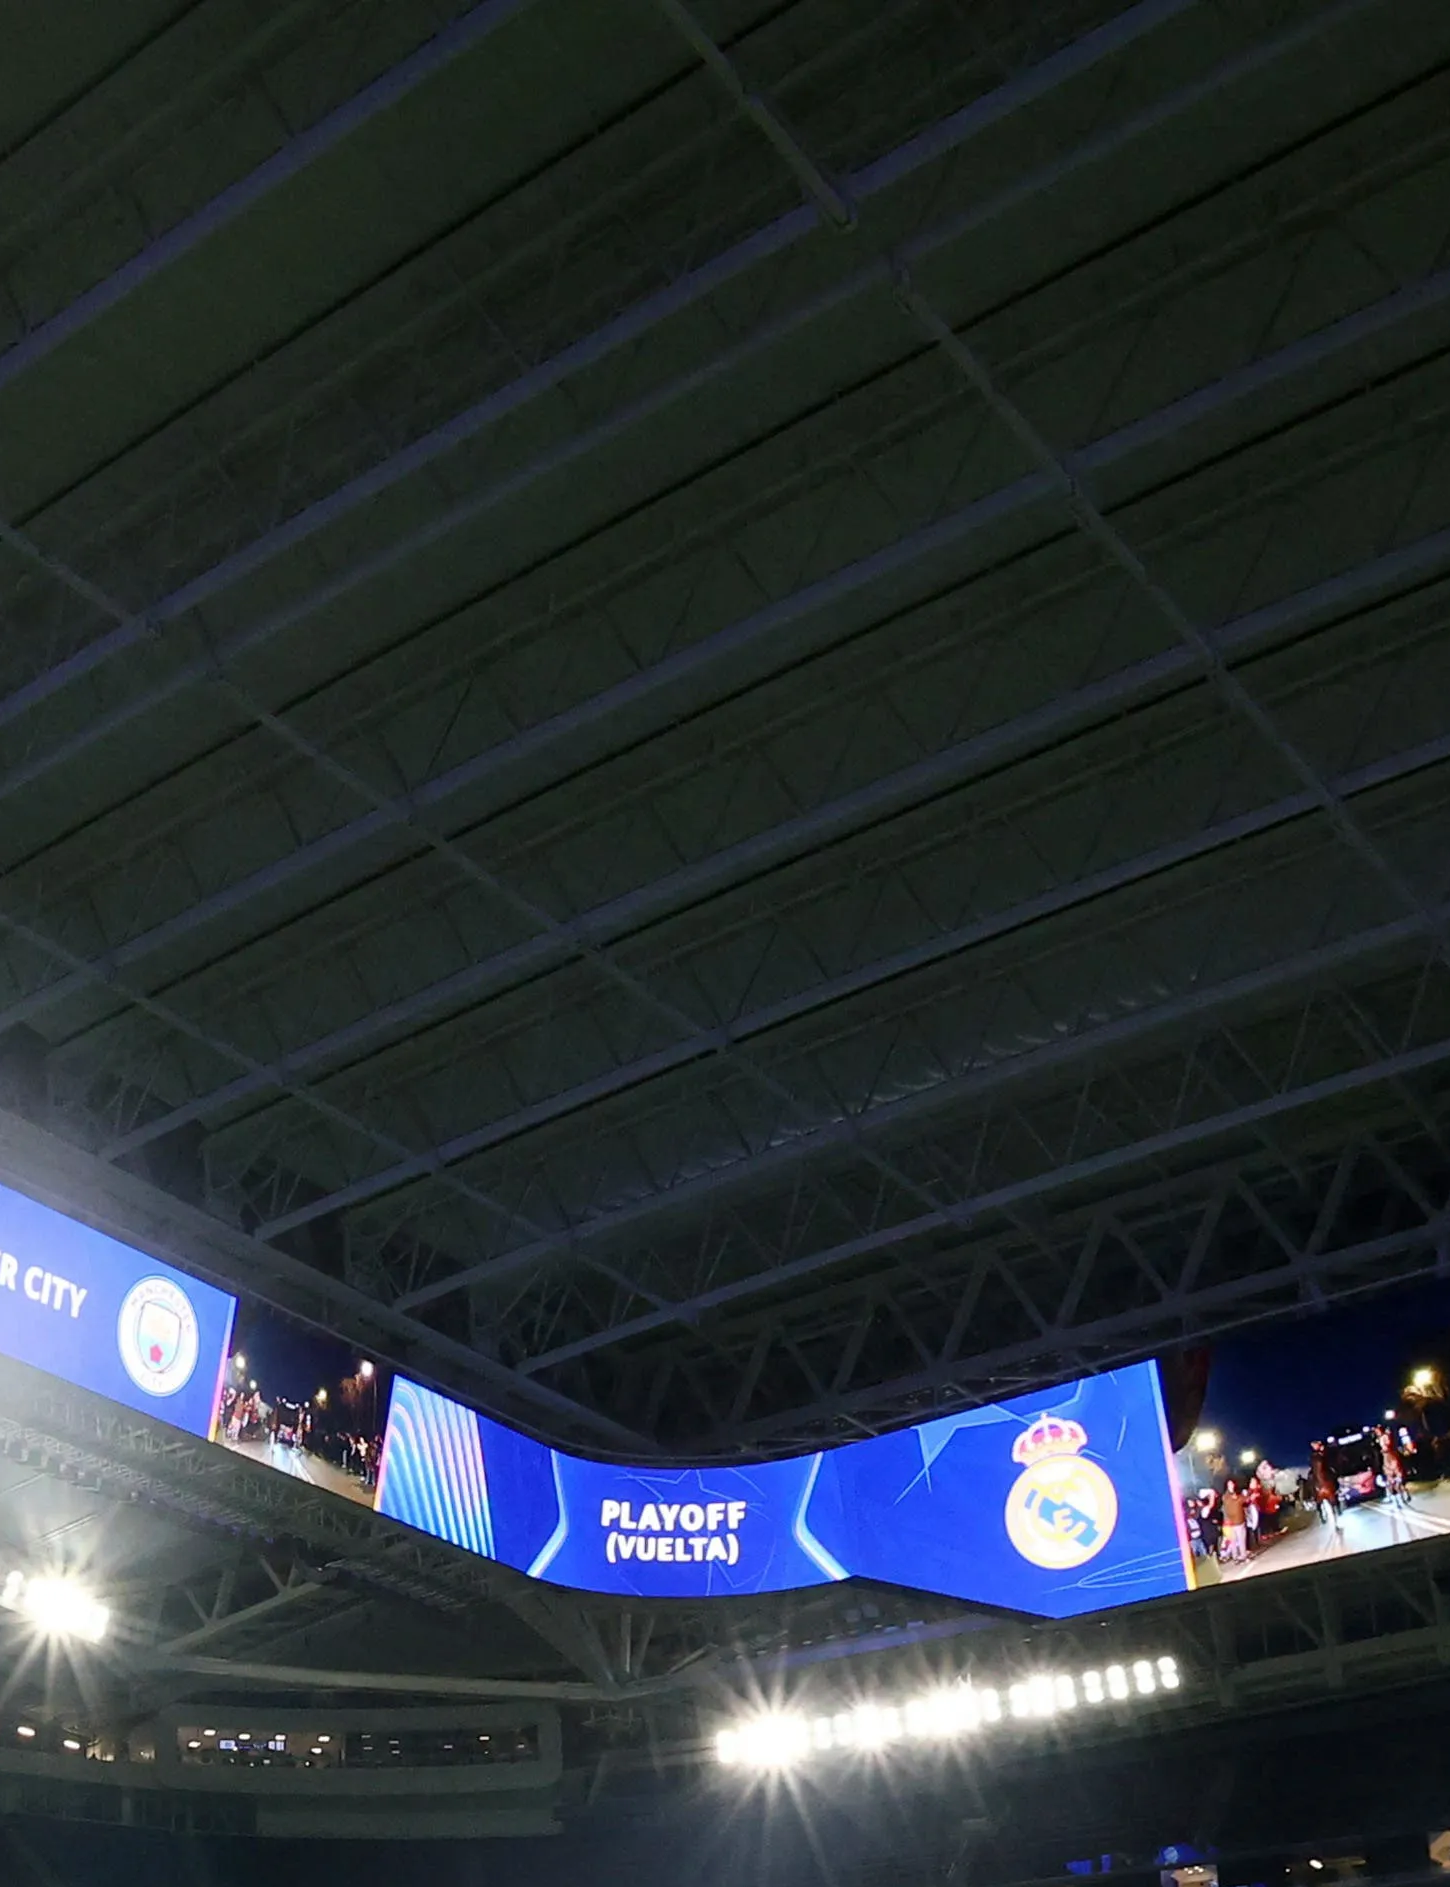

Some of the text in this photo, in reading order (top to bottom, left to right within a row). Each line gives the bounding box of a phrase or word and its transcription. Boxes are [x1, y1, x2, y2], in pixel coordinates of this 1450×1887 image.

[23, 1265, 88, 1319] CITY
[600, 1499, 746, 1532] PLAYOFF
[605, 1531, 740, 1565] (VUELTA)
